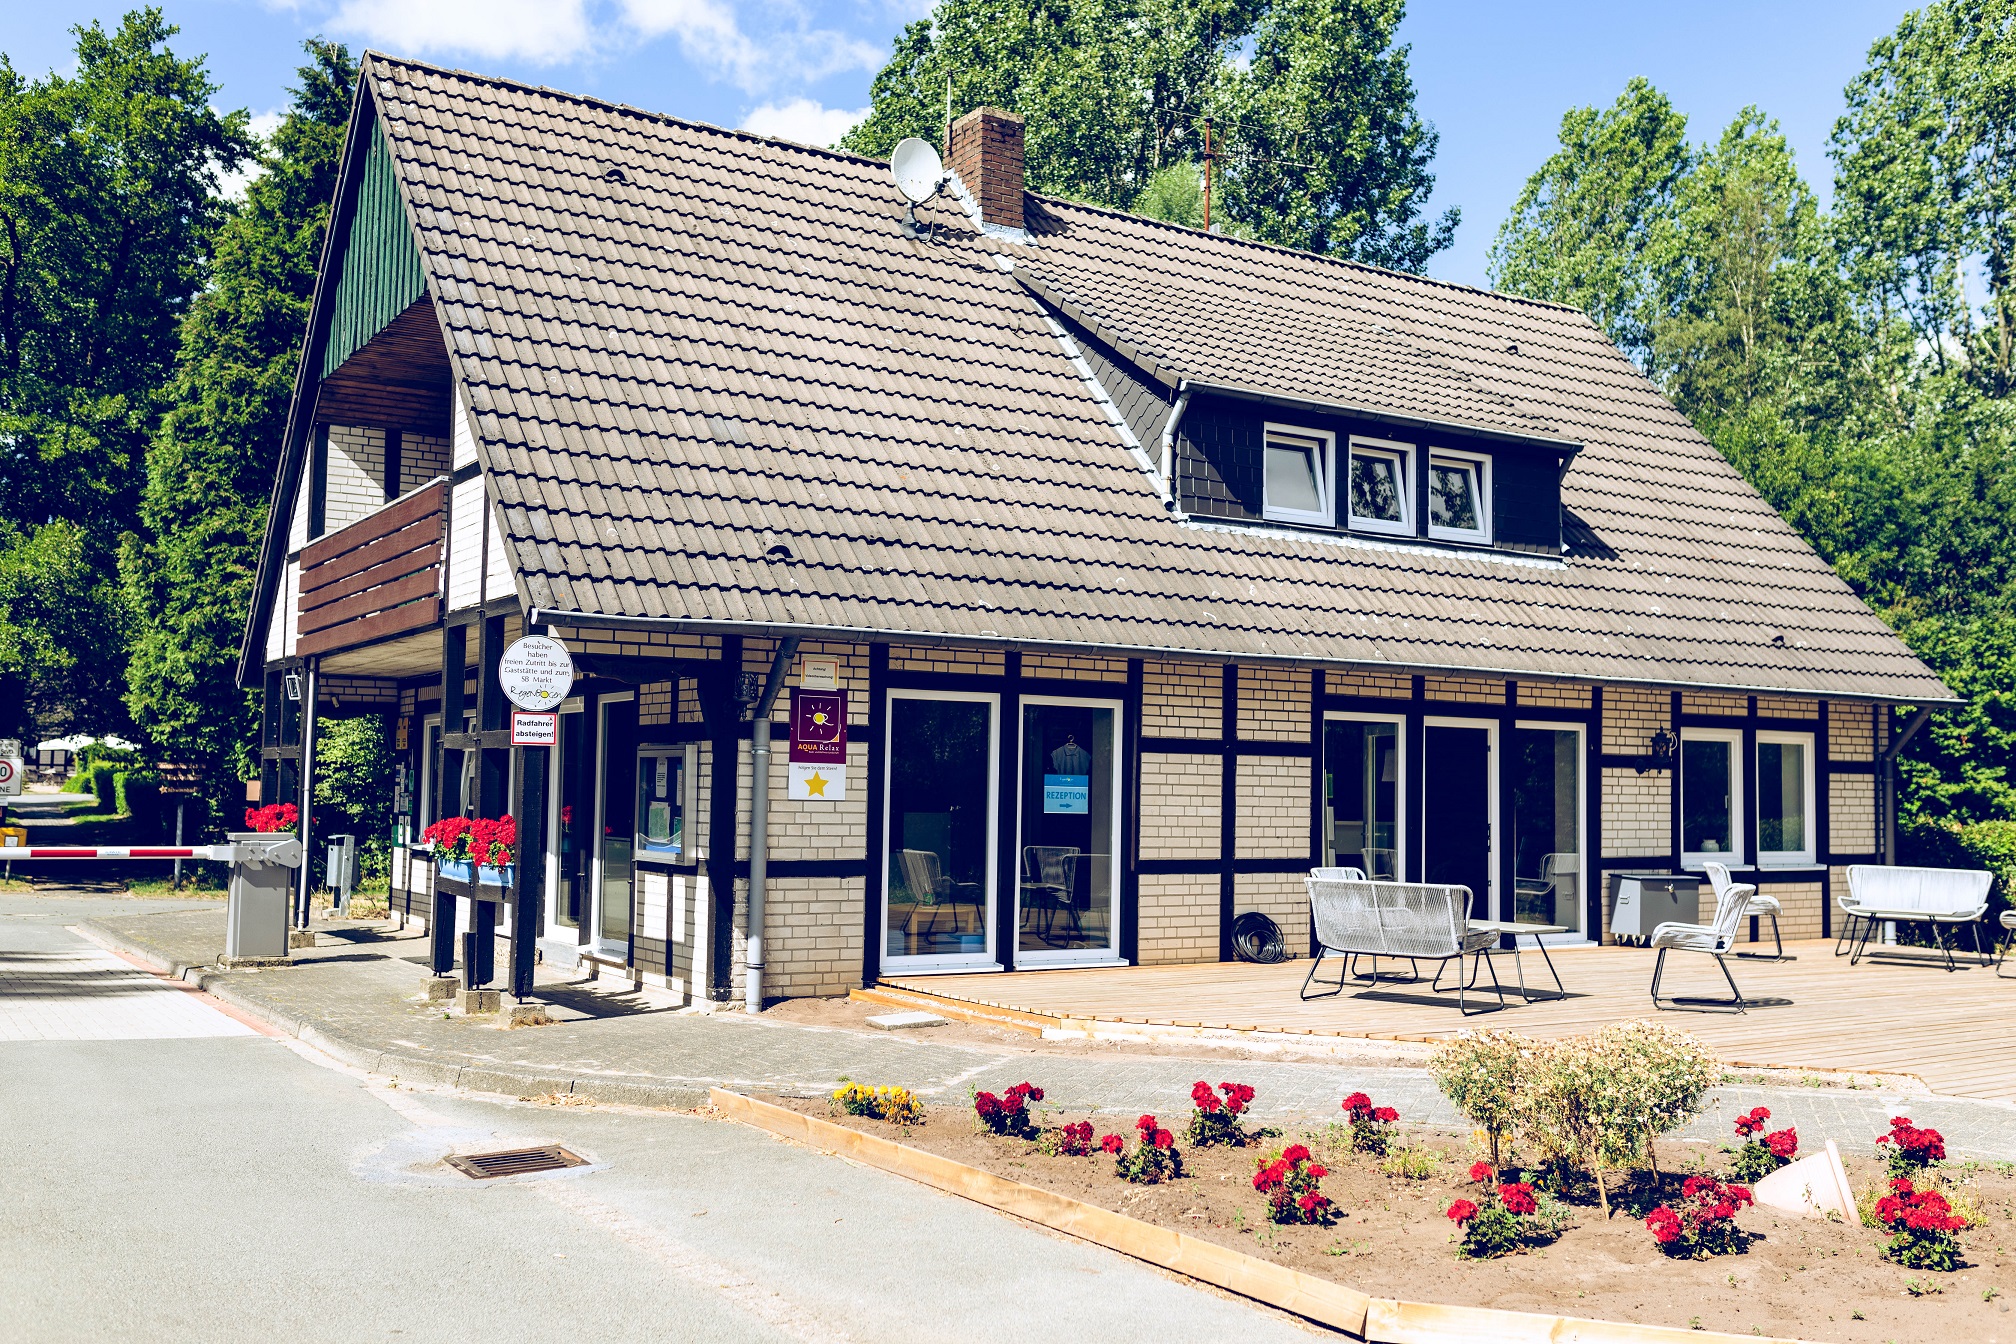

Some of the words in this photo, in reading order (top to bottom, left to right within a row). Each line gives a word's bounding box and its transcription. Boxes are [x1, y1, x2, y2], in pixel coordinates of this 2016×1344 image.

[523, 642, 552, 650] Besucher
[504, 666, 538, 674] Gaststätte
[798, 744, 818, 752] AQUA
[1046, 792, 1086, 800] REZEPTION
